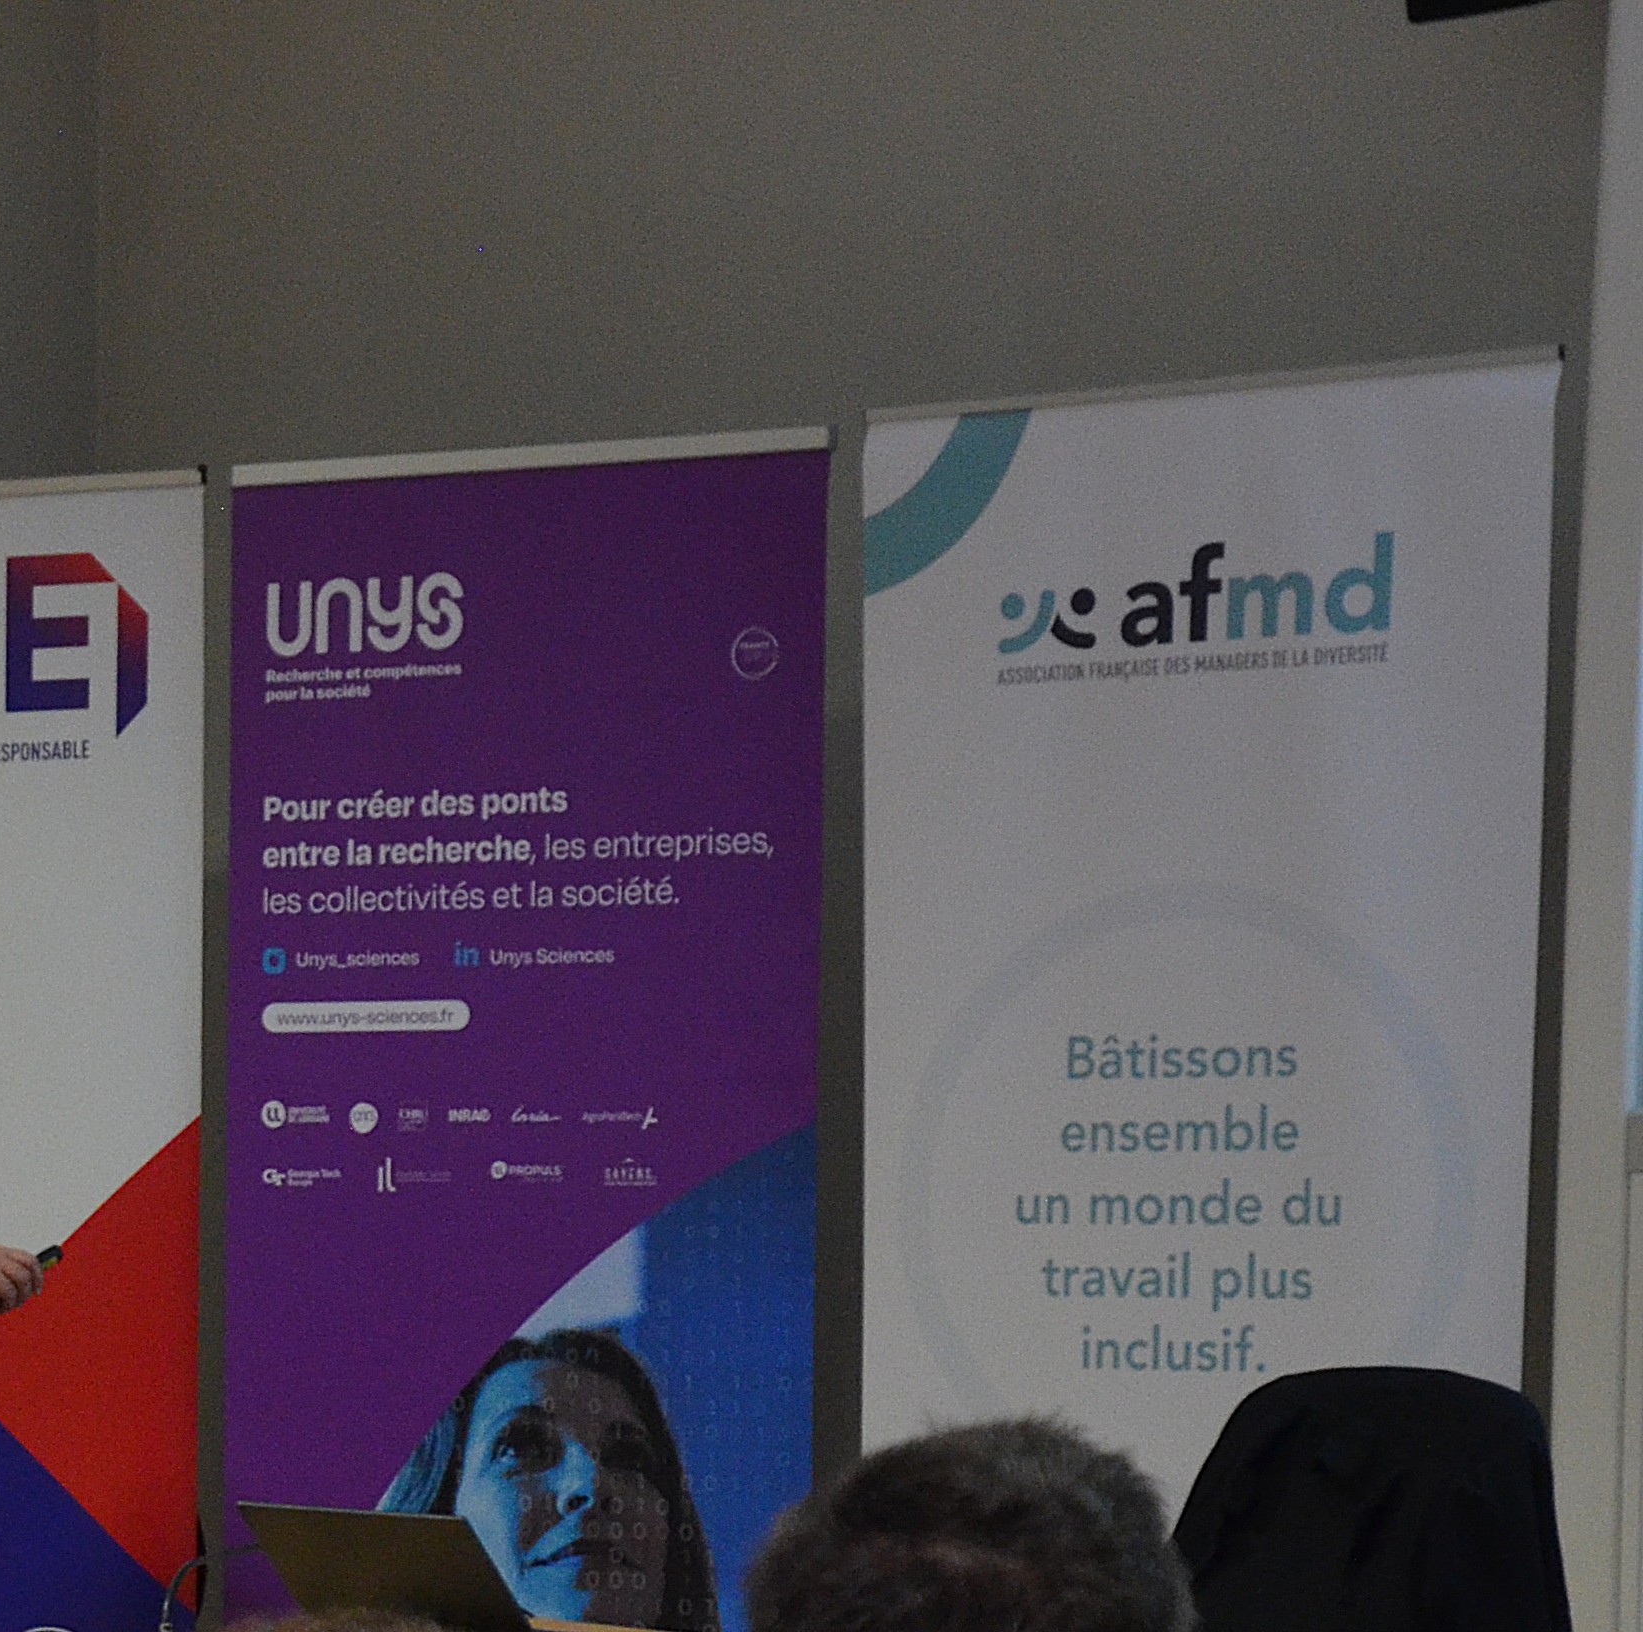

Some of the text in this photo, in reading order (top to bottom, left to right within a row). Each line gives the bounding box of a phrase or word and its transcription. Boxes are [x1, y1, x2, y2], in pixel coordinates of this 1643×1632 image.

[1121, 531, 1395, 647] afmd
[266, 662, 462, 683] Recherche et compétences
[998, 642, 1389, 687] ASSOCIATION FRANÇAISE DES MANAGERS DE LA DIVERSITÉ
[265, 684, 370, 703] pour la société
[264, 786, 568, 821] Pour créer des ponts
[263, 828, 775, 869] entre la recherche, les entreprises,
[263, 876, 680, 914] les collectivités et la société.
[296, 949, 420, 970] Unys_sciences
[490, 946, 615, 967] Unys Sciences
[277, 1006, 454, 1028] www.unys-sciences.fr
[1068, 1035, 1297, 1080] Bâtissons
[1061, 1105, 1299, 1151] ensemble
[1016, 1177, 1341, 1226] un monde du
[1042, 1252, 1313, 1312] travail plus
[1082, 1325, 1266, 1371] inclusif.
